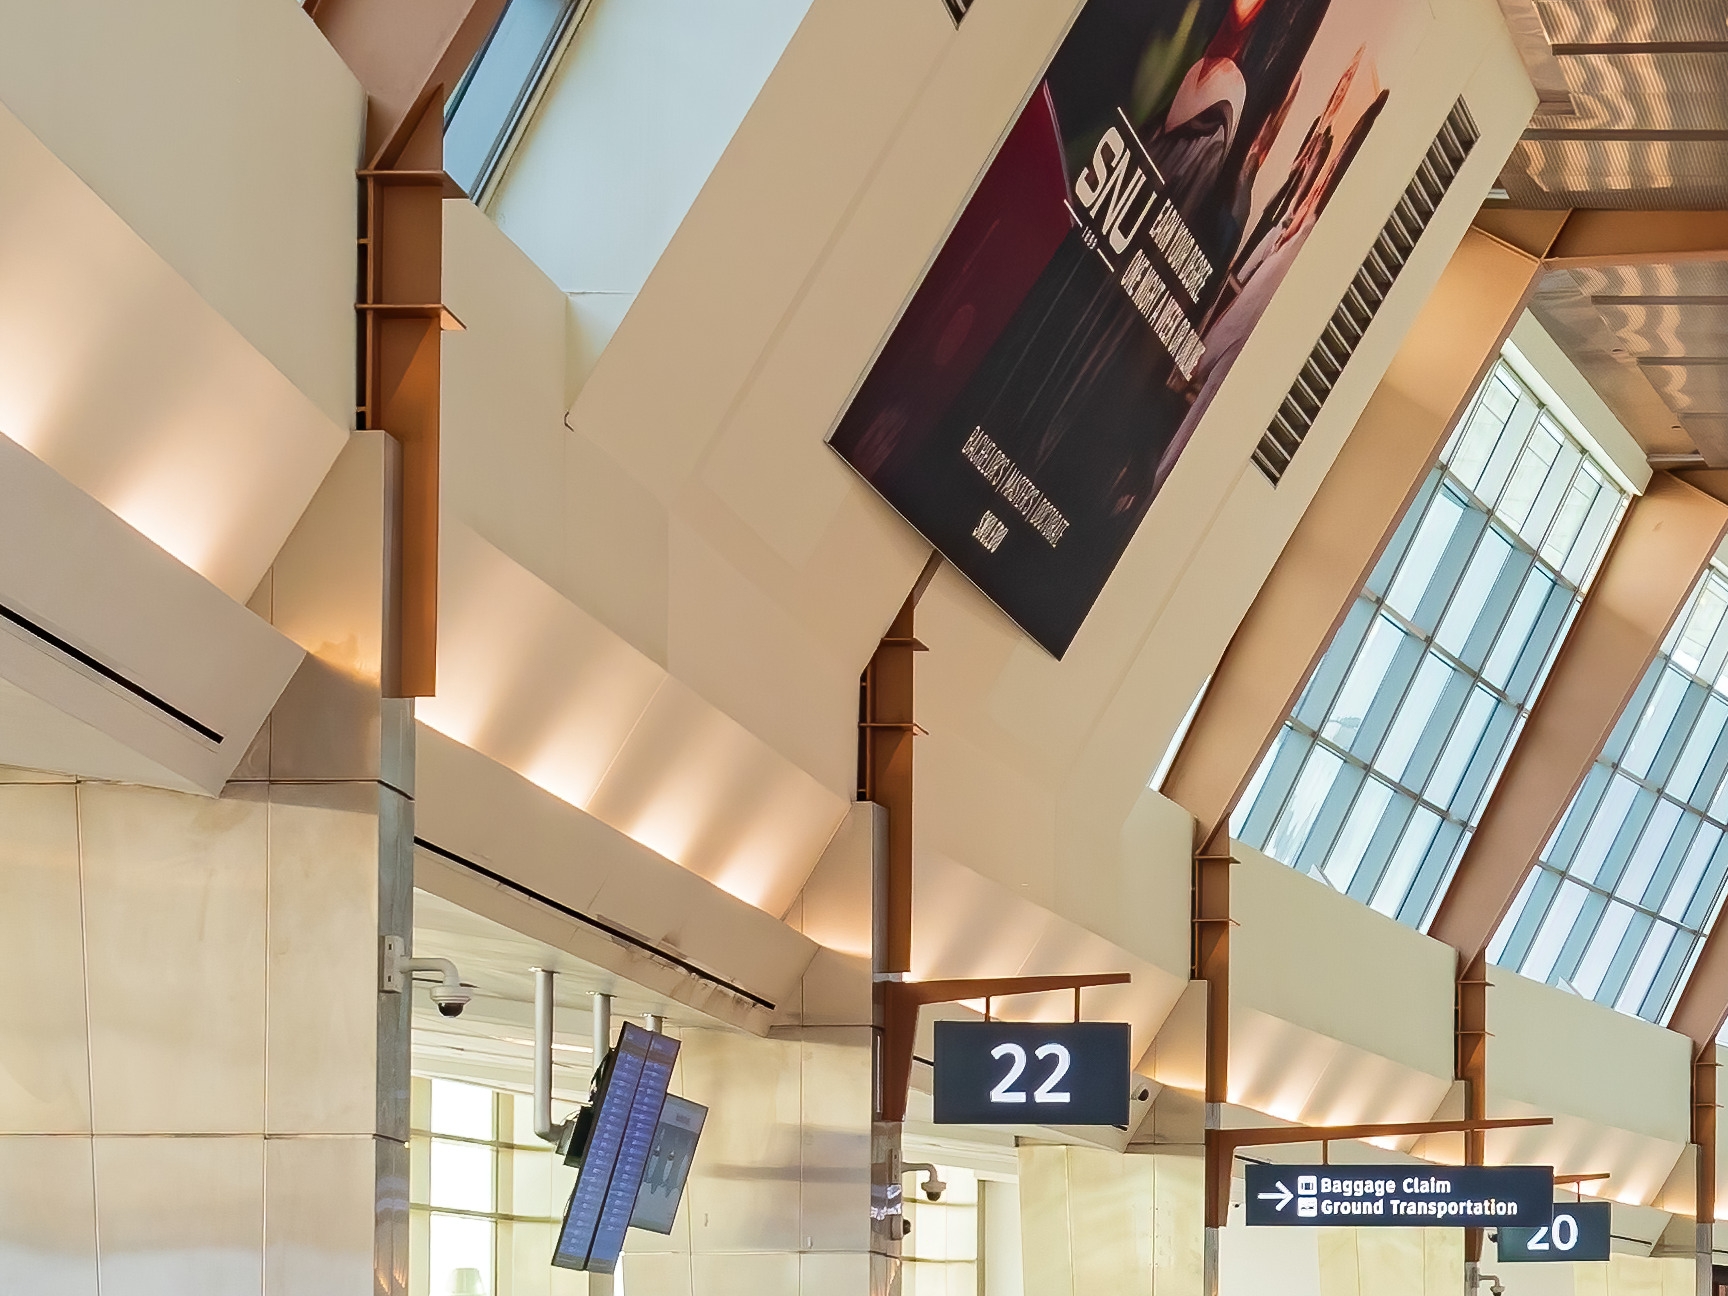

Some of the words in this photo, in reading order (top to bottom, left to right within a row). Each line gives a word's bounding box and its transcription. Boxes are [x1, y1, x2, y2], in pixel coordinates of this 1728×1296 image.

[1075, 126, 1158, 255] SNU
[1121, 249, 1150, 296] ONE
[1164, 216, 1196, 282] YOUR
[990, 1043, 1071, 1103] 22
[1321, 1177, 1396, 1196] Baggage
[1402, 1176, 1451, 1194] Claim
[1321, 1198, 1384, 1216] Ground
[1391, 1198, 1518, 1218] Transportation
[1527, 1214, 1579, 1251] 20
